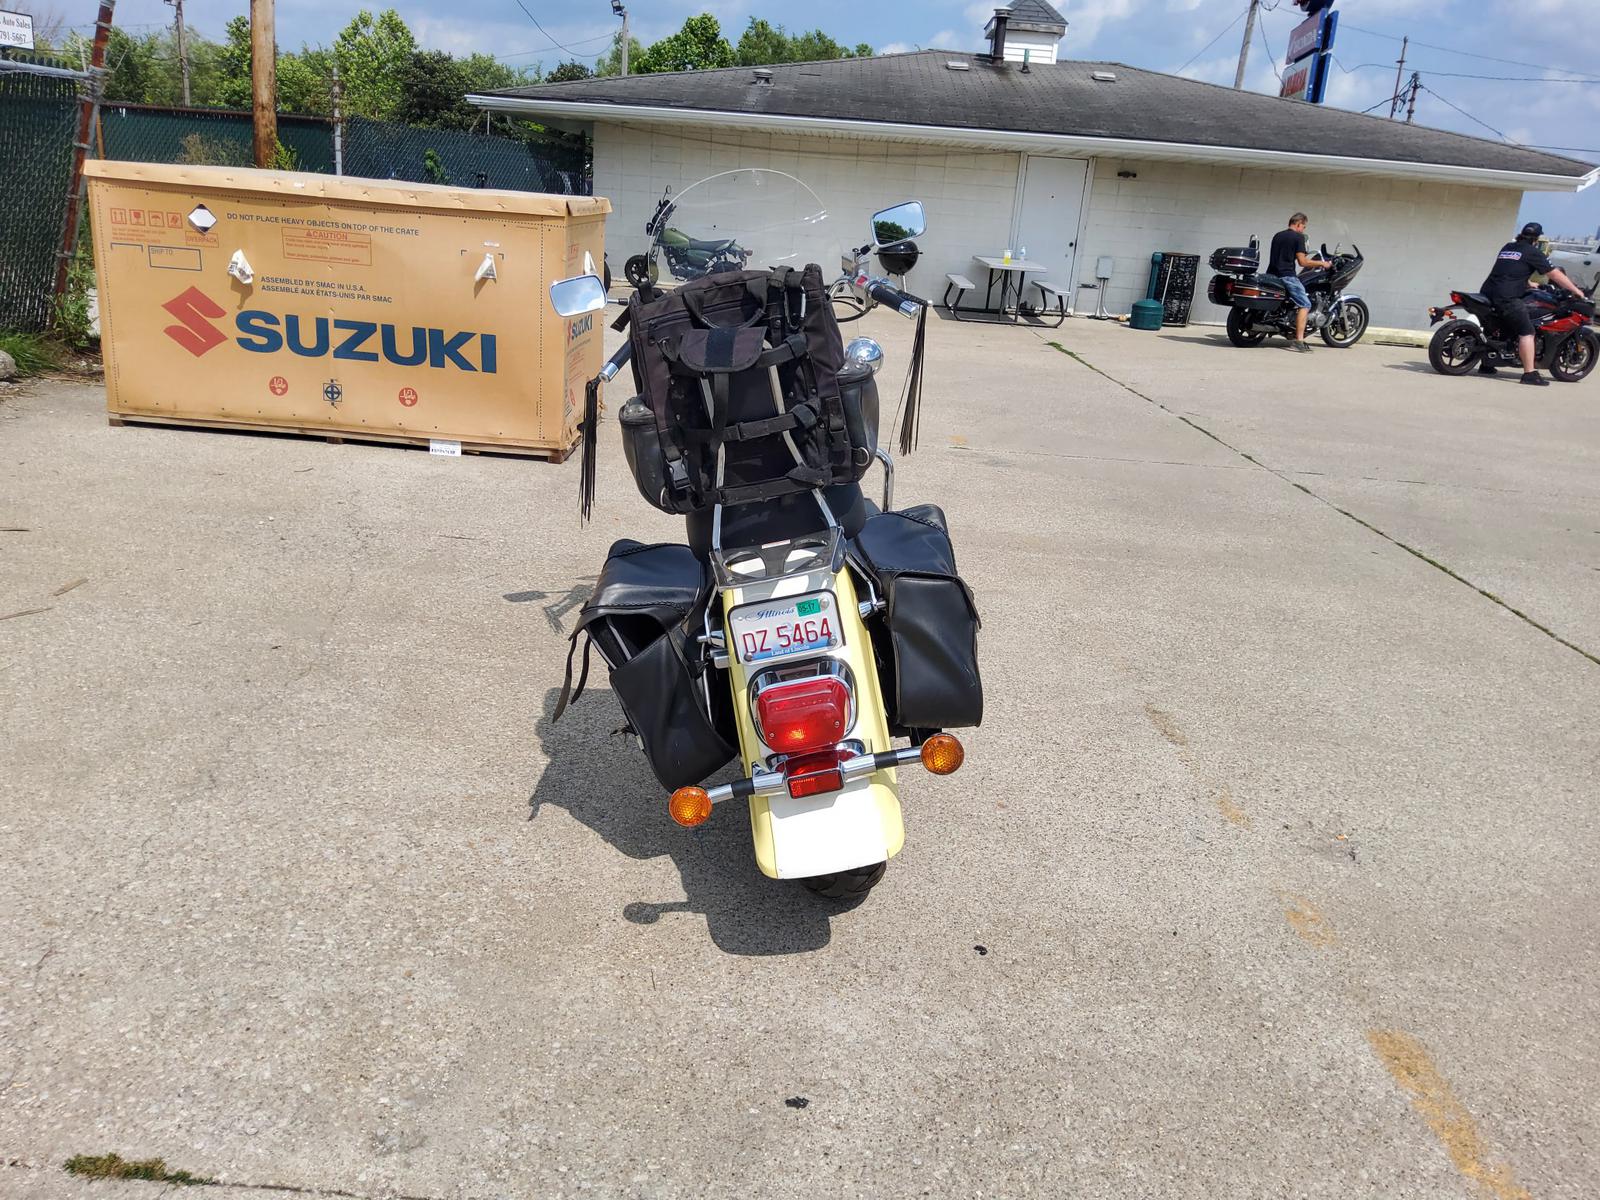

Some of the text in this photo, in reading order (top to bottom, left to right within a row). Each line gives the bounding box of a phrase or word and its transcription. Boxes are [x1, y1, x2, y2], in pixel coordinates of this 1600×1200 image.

[3, 16, 31, 29] Auto Sales
[239, 213, 254, 221] NOT
[256, 215, 280, 224] PLACE
[281, 217, 305, 225] HEAVY
[307, 219, 340, 229] OBJECTS
[353, 223, 367, 231] TOP
[380, 226, 394, 234] THE
[395, 228, 419, 236] CRATE
[312, 230, 348, 240] CAUTION
[260, 276, 303, 286] ASSEMBLED
[305, 279, 314, 287] BY
[316, 281, 336, 289] SMAC
[346, 284, 366, 292] U.S.A.
[301, 288, 315, 296] AUX
[357, 293, 371, 301] PAR
[372, 295, 393, 304] SMAC
[571, 313, 593, 341] SUZUKI
[235, 310, 497, 374] SUZUKI
[756, 607, 796, 620] Illinois
[742, 618, 832, 654] DZ 5464
[771, 648, 784, 656] Land
[790, 644, 810, 653] Lincoln
